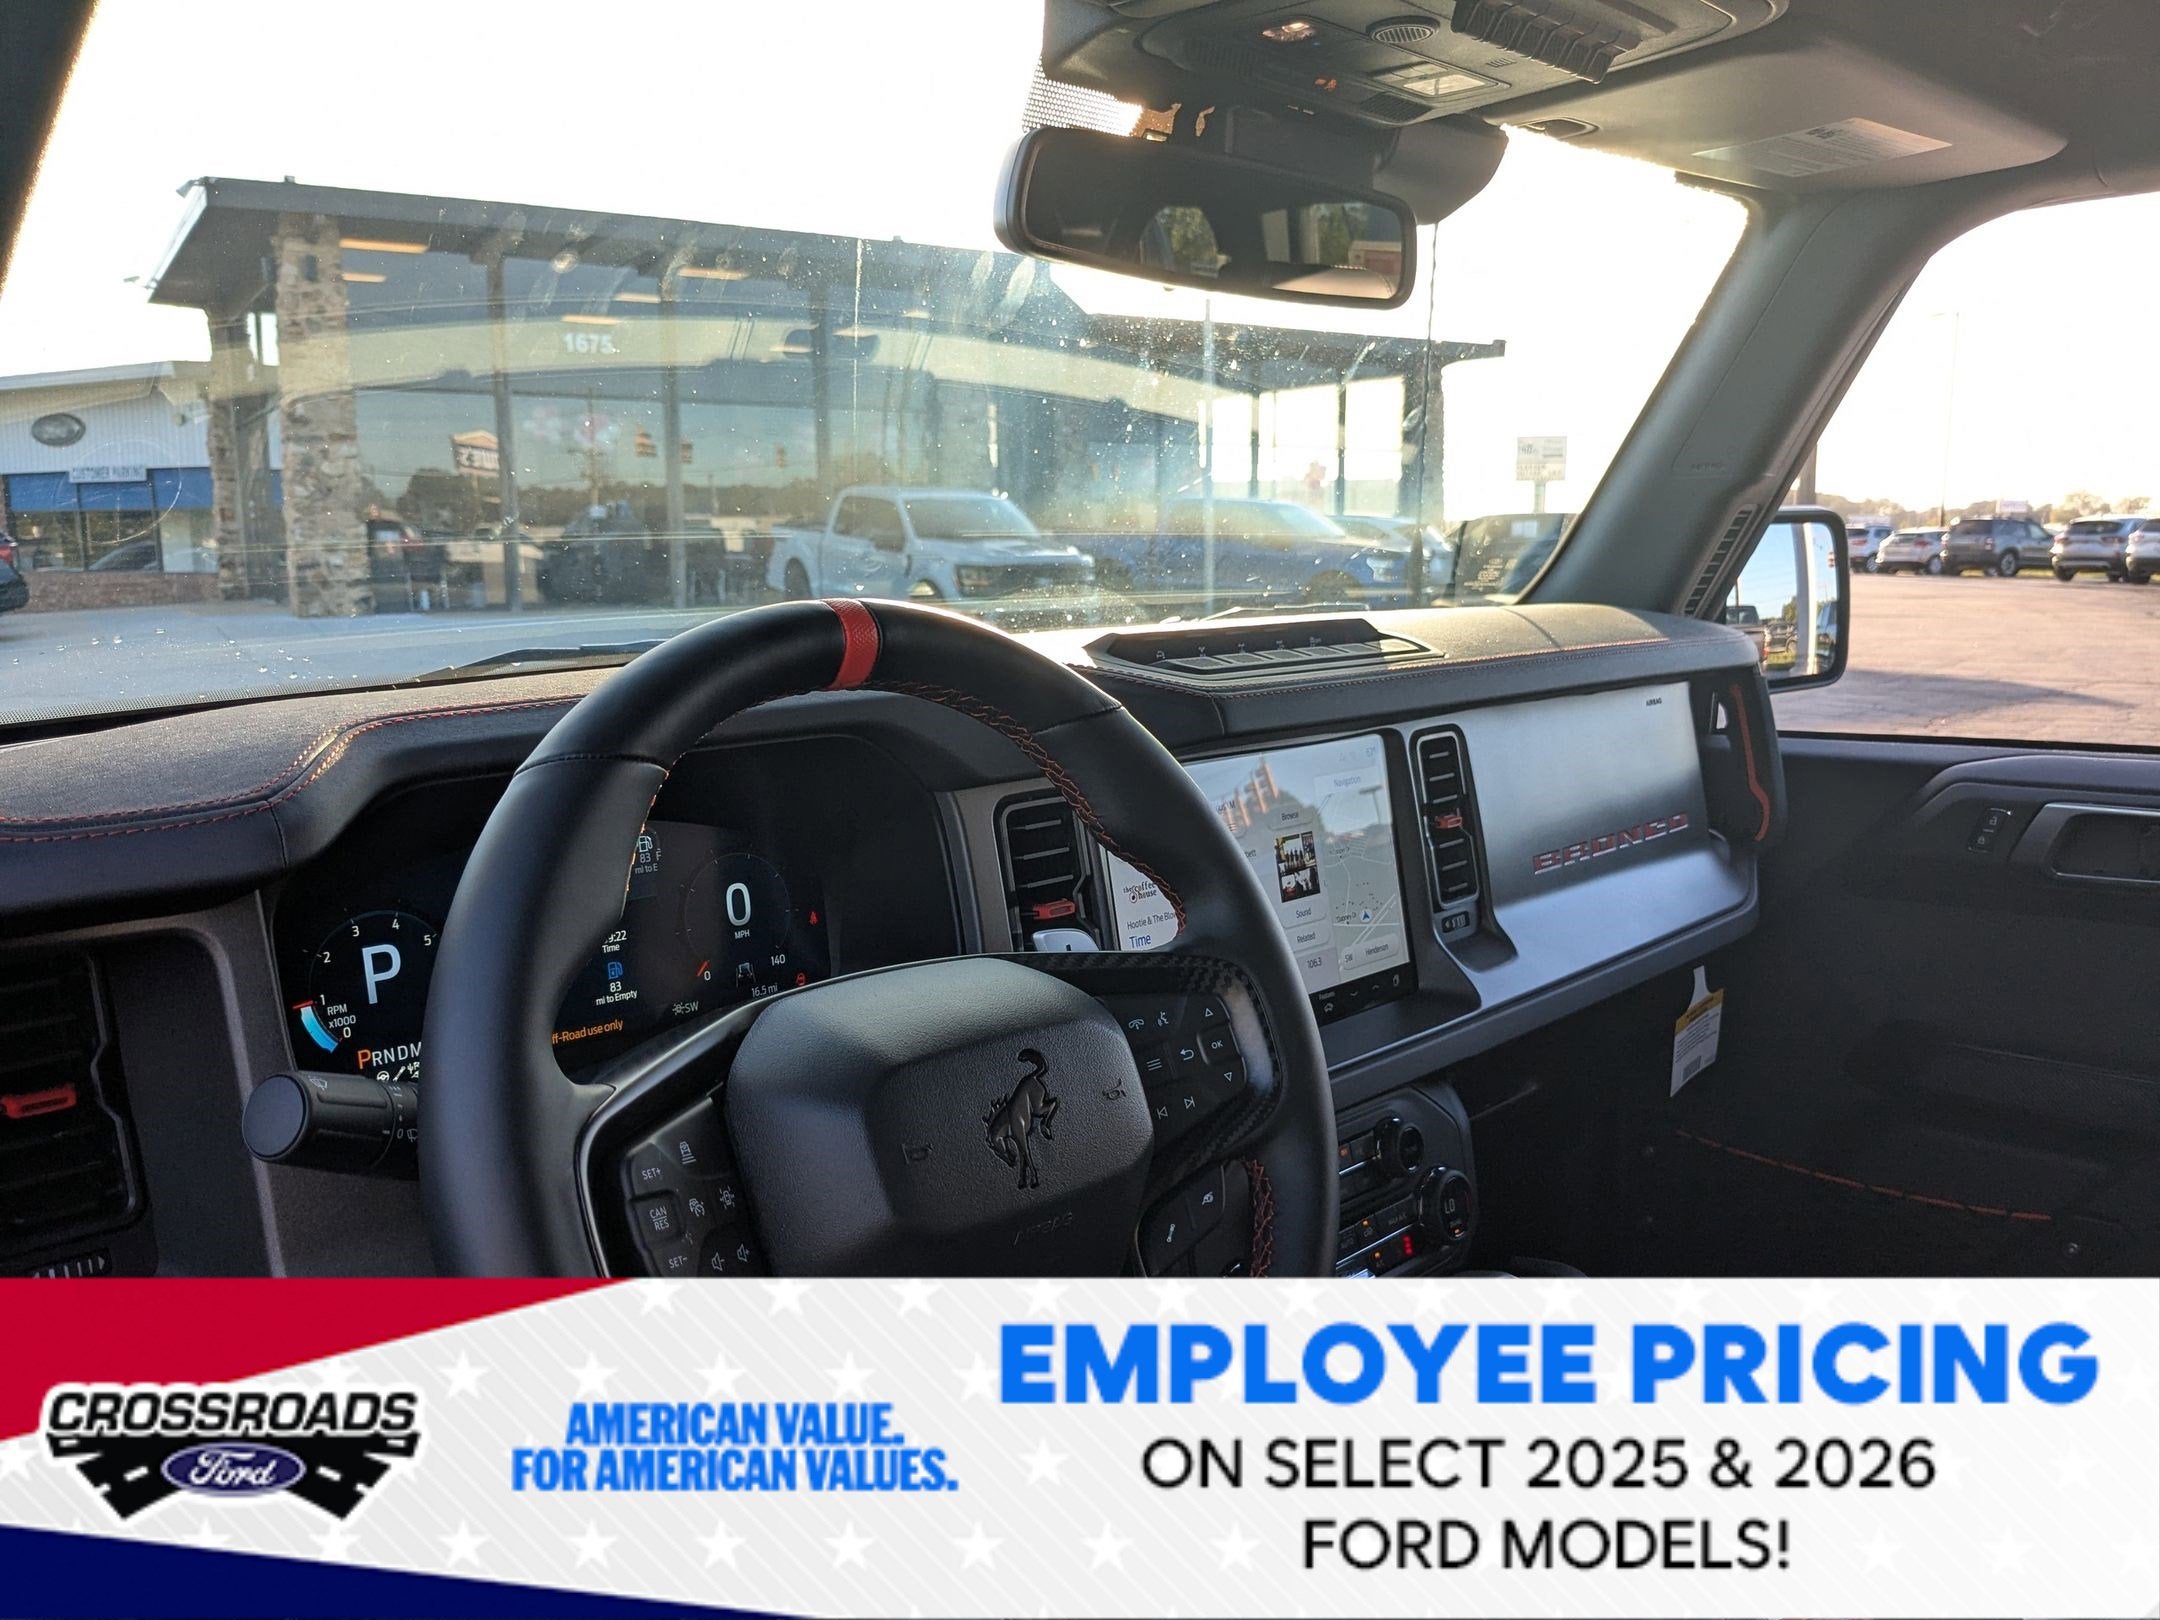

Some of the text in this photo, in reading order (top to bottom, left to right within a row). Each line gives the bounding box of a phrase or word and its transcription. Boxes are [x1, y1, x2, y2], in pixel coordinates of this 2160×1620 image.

[563, 332, 614, 354] 1675
[1334, 775, 1362, 788] Navigation
[1281, 811, 1299, 821] Browse
[1533, 812, 1689, 875] BRONCO
[639, 853, 651, 863] 83
[726, 882, 751, 927] 0
[1295, 907, 1312, 919] Sound
[392, 918, 400, 930] 4
[1126, 918, 1147, 930] Hootie
[1147, 916, 1153, 925] &
[1153, 913, 1164, 923] The
[352, 925, 360, 937] 3
[734, 929, 751, 940] MPH
[1296, 931, 1316, 943] Related
[423, 935, 432, 946] 5
[1129, 934, 1152, 949] Time
[602, 943, 620, 953] Time
[1365, 943, 1389, 956] Henderson
[323, 952, 331, 963] 2
[770, 954, 786, 966] 140
[362, 944, 402, 1005] P
[704, 971, 711, 981] 0
[609, 981, 622, 993] 83
[751, 984, 778, 998] 16.5 mi
[320, 994, 326, 1006] 1
[596, 990, 638, 1006] mi to Empty
[327, 1003, 348, 1016] RPM
[684, 1001, 699, 1013] SW
[328, 1015, 357, 1029] x1000
[343, 1027, 351, 1038] 0
[551, 1019, 624, 1046] ff-Road use only
[1211, 1040, 1223, 1049] OK
[641, 1167, 661, 1181] SET+
[650, 1205, 667, 1218] CAN
[653, 1220, 670, 1231] RES
[668, 1255, 688, 1269] SET-
